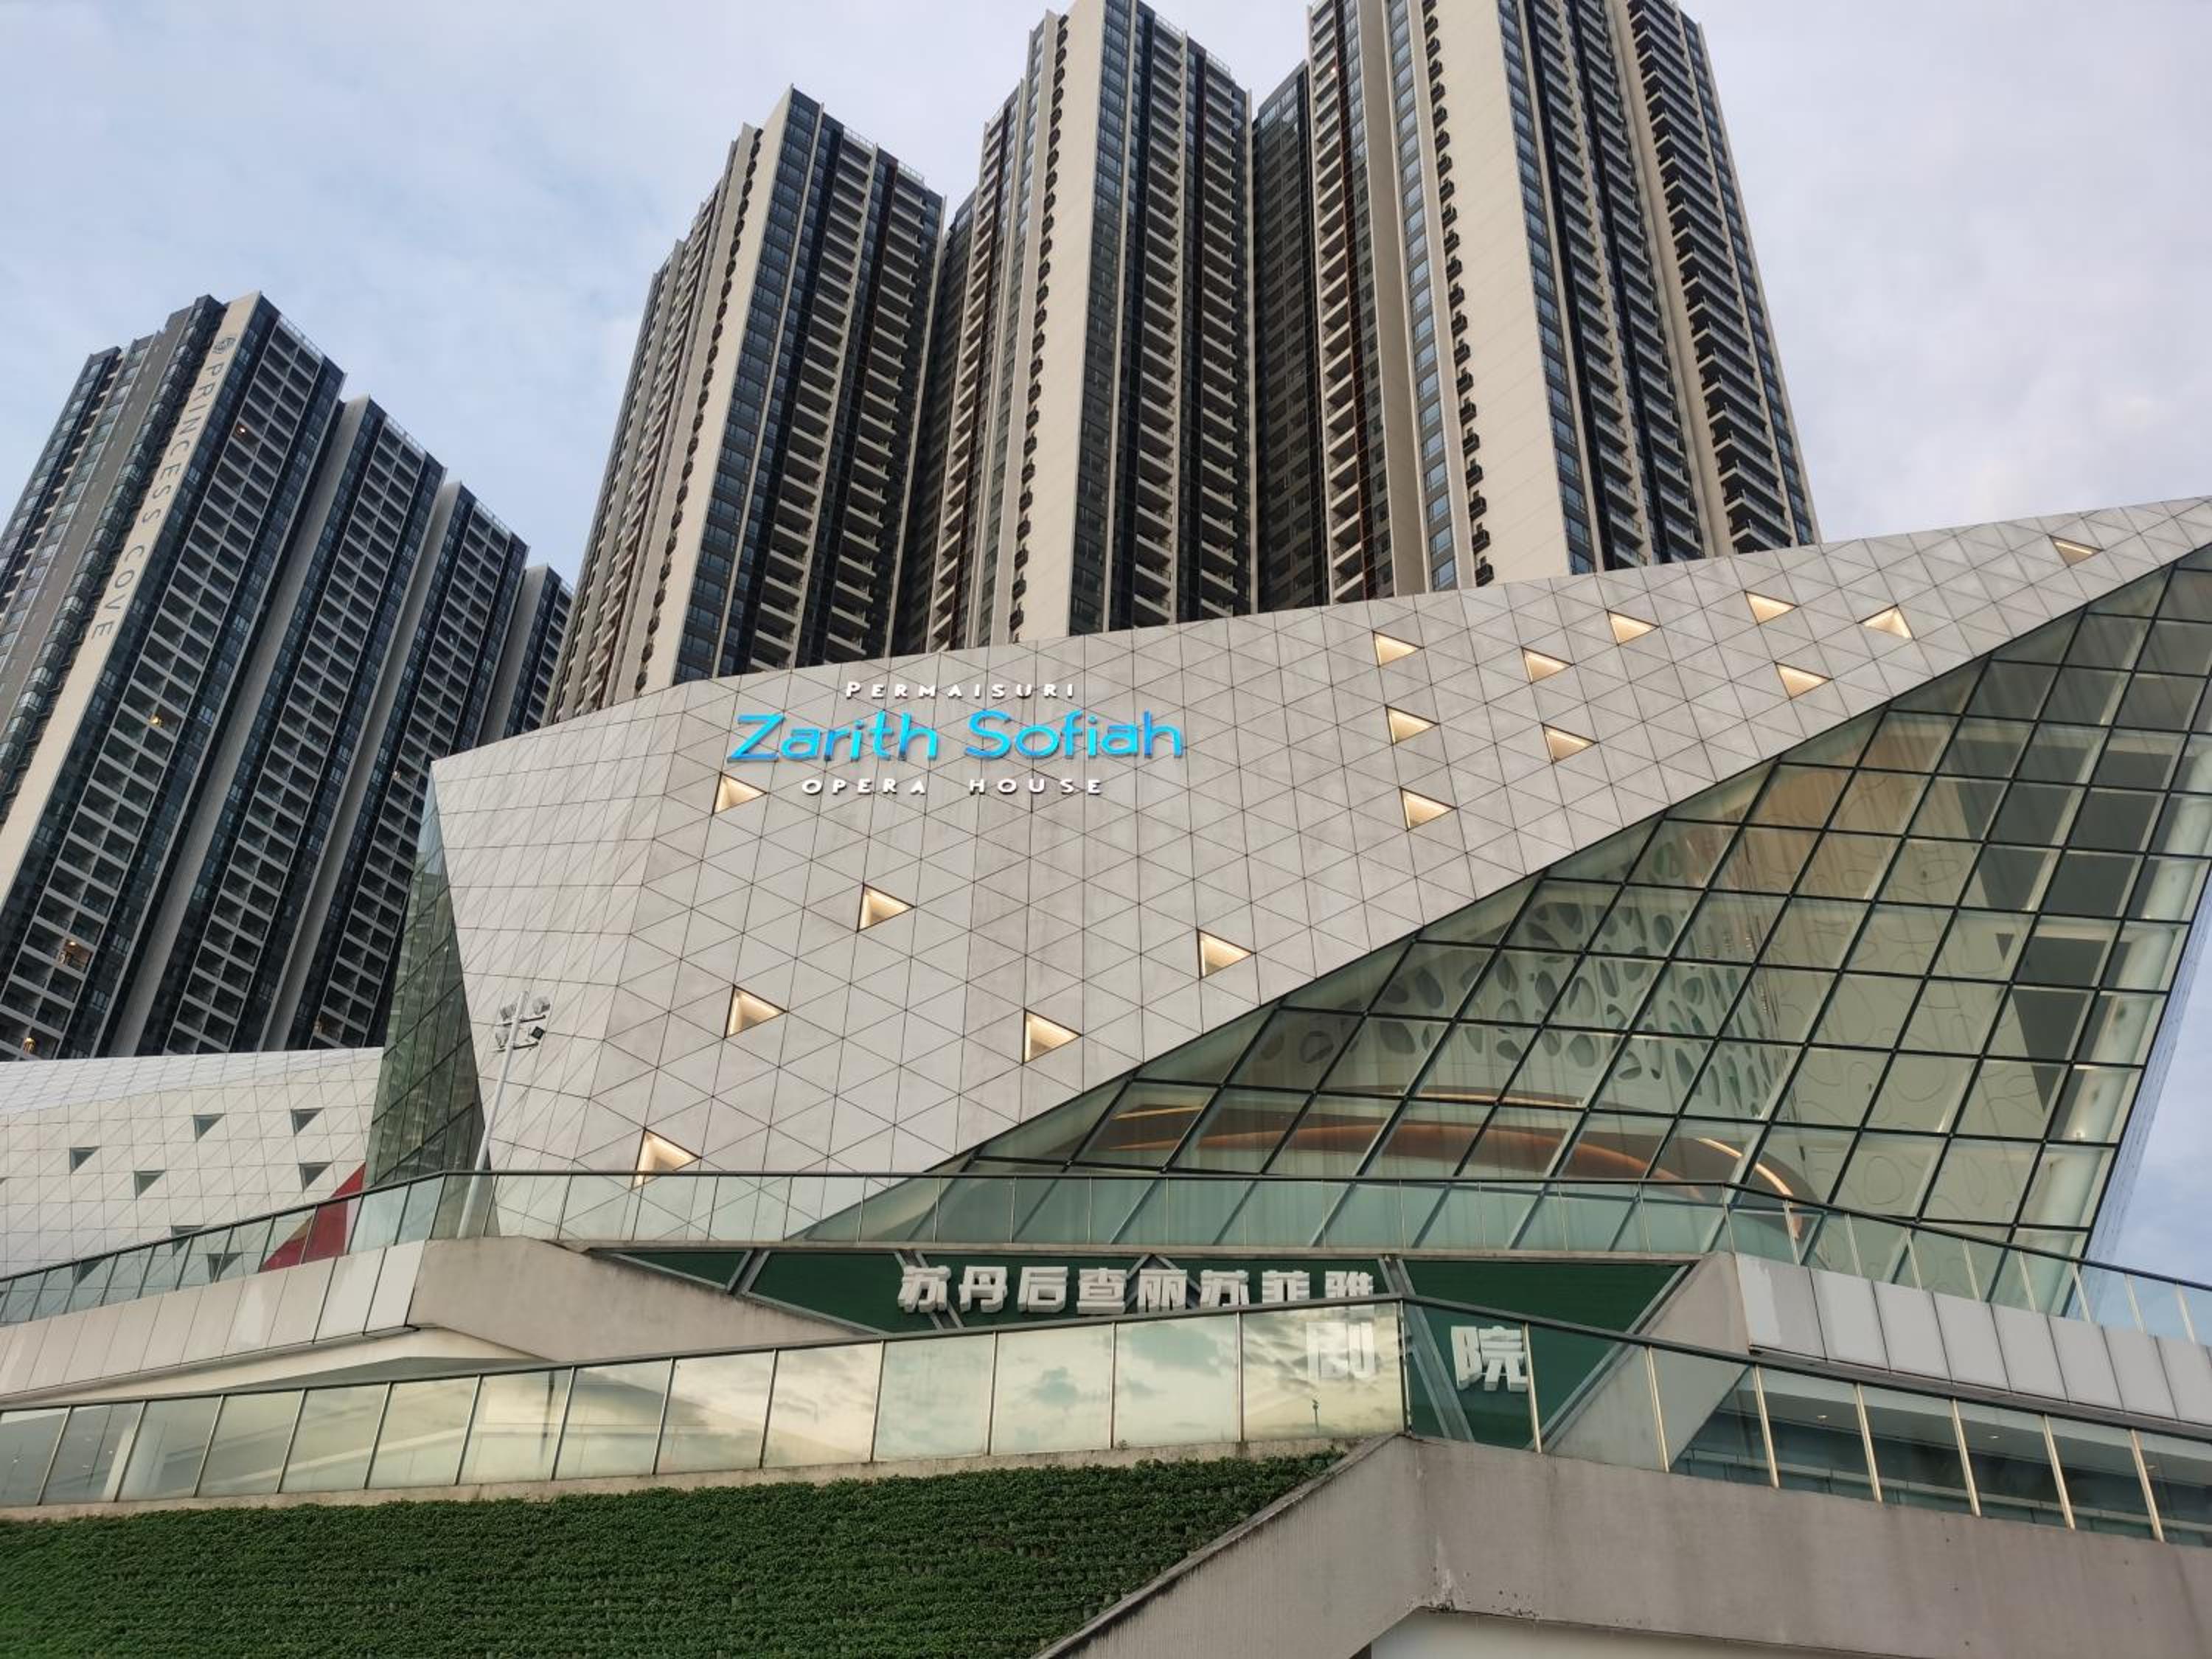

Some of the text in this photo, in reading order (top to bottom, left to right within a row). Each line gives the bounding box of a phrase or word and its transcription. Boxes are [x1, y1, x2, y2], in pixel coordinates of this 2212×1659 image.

[91, 361, 224, 639] PRINCESS COVE
[846, 681, 1075, 699] PERMAISURI
[727, 709, 1183, 763] Zarith Sofiah
[801, 779, 1103, 796] OPERA HOUSE
